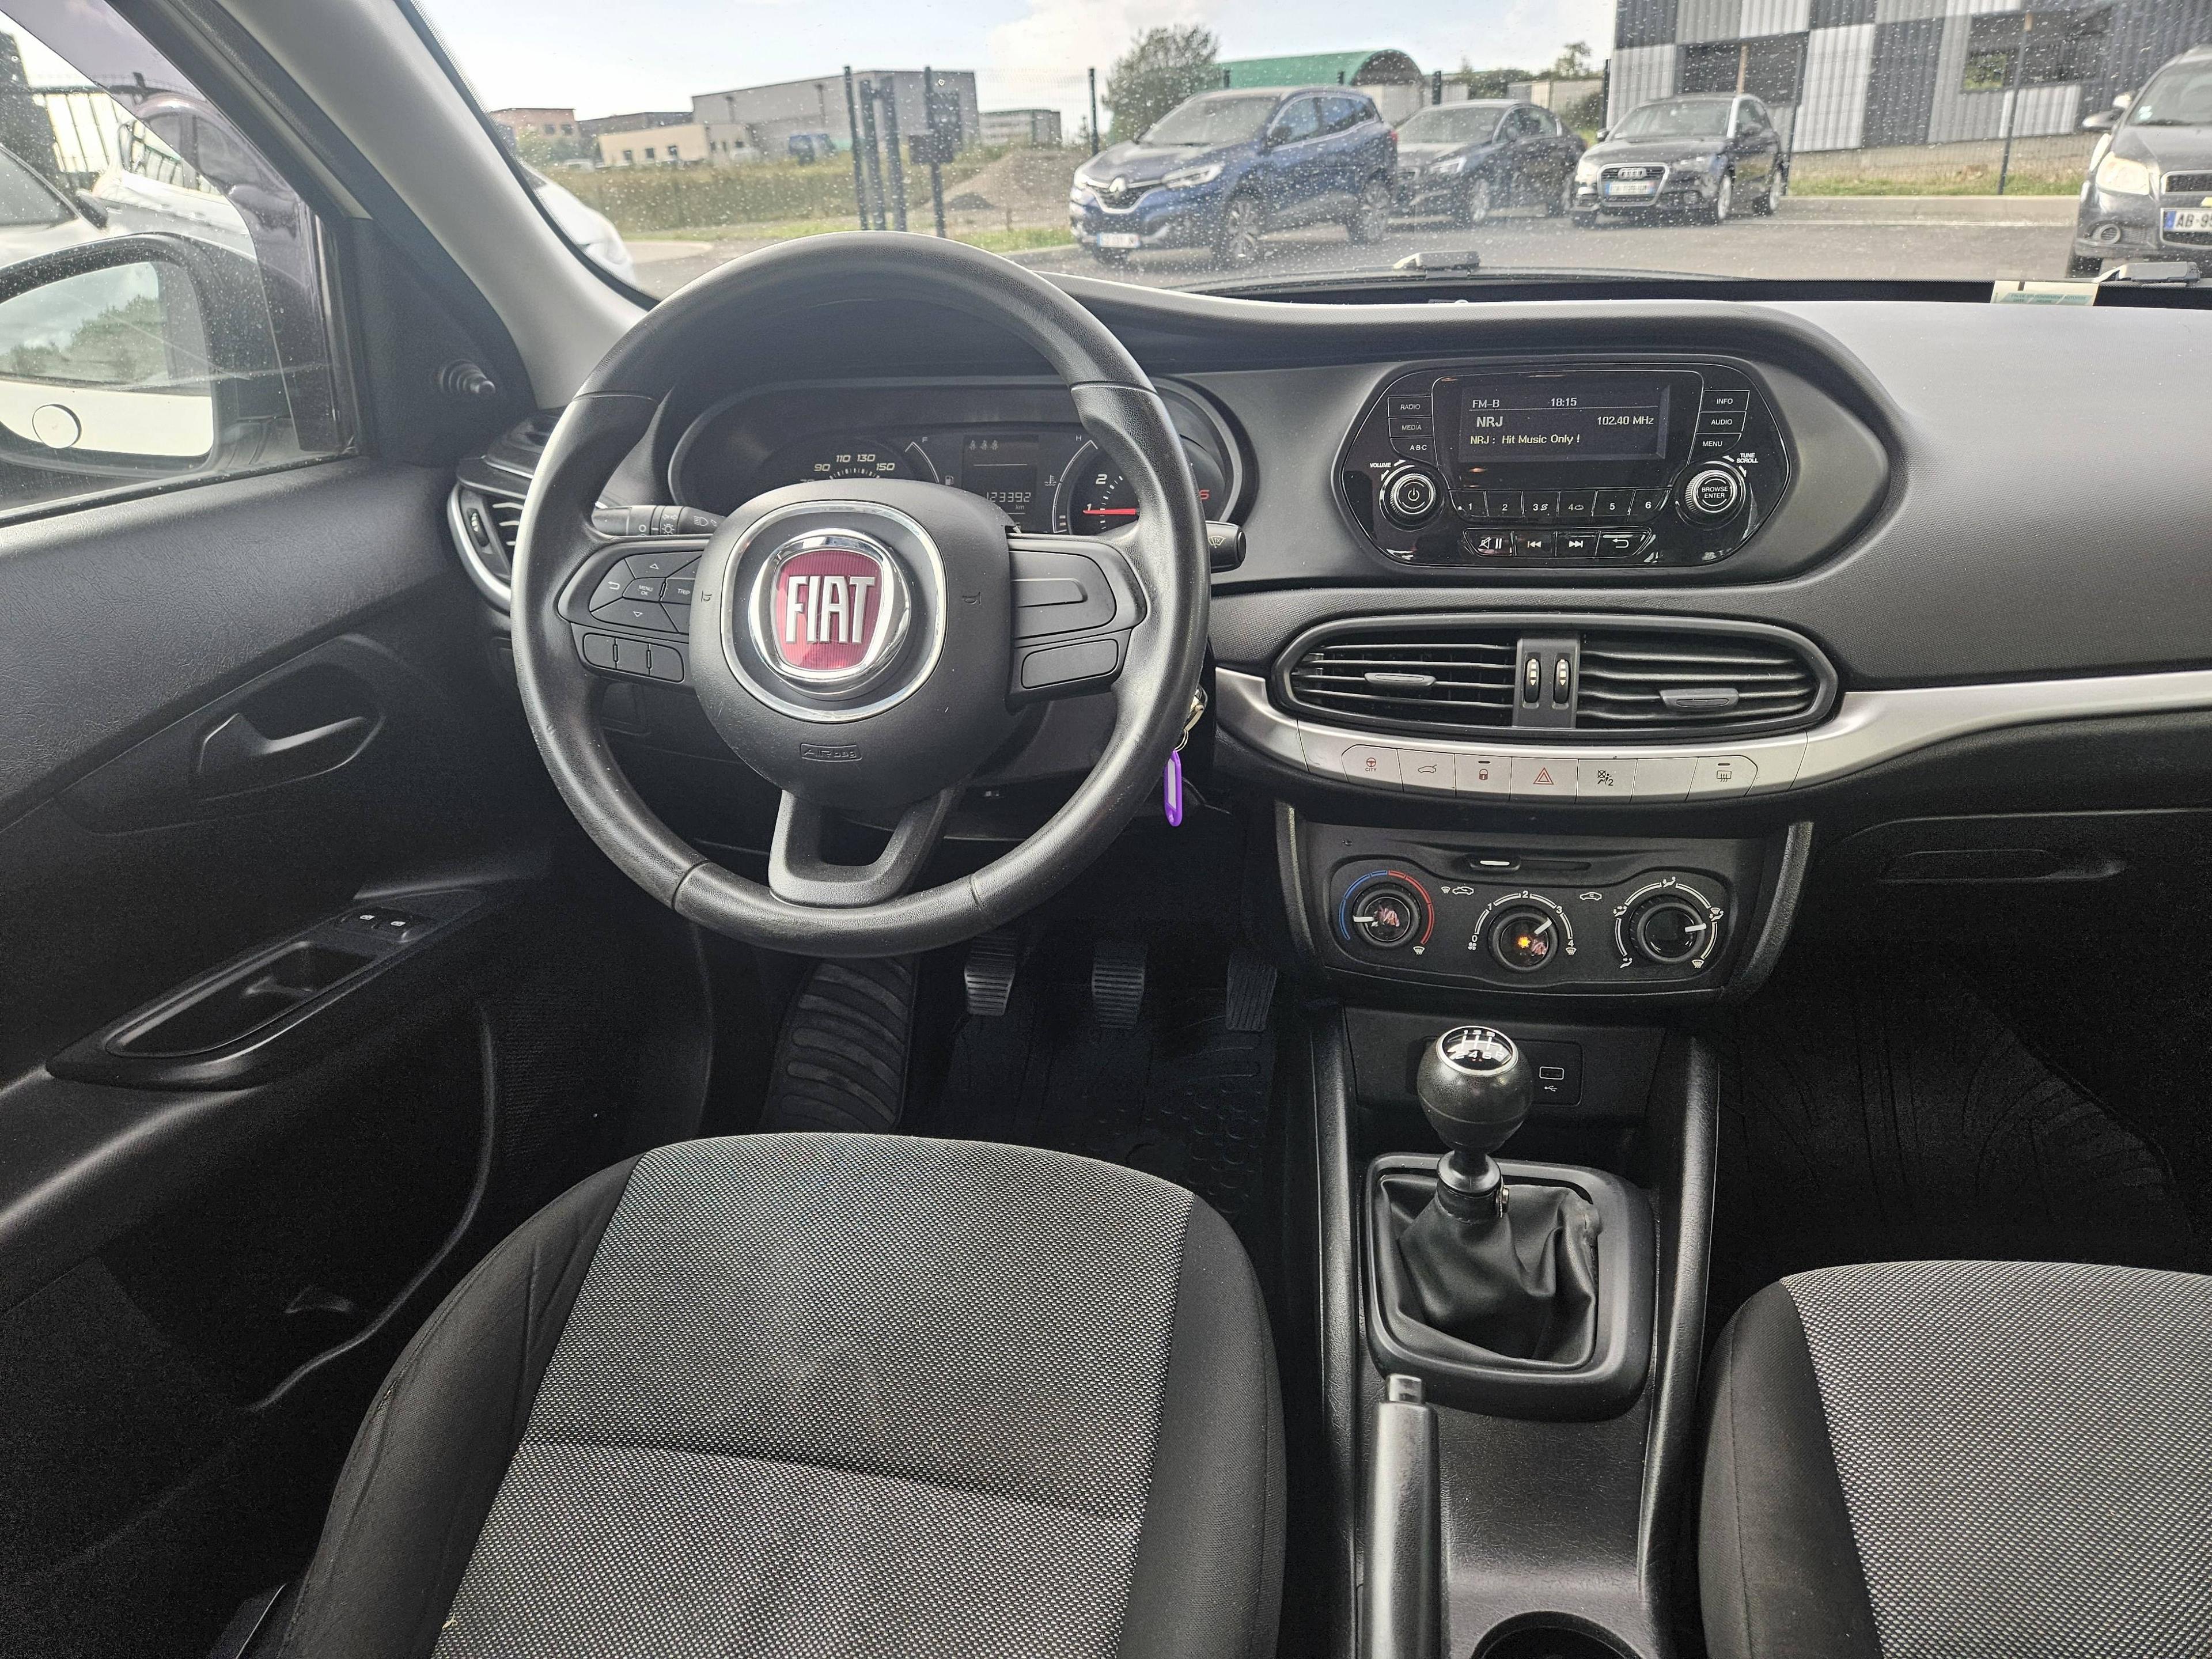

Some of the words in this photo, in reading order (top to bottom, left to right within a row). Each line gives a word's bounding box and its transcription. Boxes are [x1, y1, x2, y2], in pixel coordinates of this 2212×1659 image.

[1472, 399, 1500, 408] FM-B
[1551, 397, 1577, 407] 18:15
[1476, 416, 1503, 427] NRJ
[1597, 416, 1630, 425] 102.40
[1633, 415, 1654, 425] MHz
[1470, 435, 1490, 444] NRJ
[1502, 435, 1517, 444] Hit
[1518, 434, 1547, 444] Music
[1550, 434, 1574, 445] Only
[836, 454, 851, 463] 110
[857, 454, 876, 462] 130
[814, 464, 831, 472] 90
[876, 463, 895, 471] 150
[1095, 474, 1108, 484] 2
[1645, 501, 1652, 509] 6
[786, 575, 876, 645] FIAT
[1522, 891, 1529, 899] 2
[1487, 903, 1493, 911] 1
[1556, 906, 1563, 914] 3
[1469, 1050, 1478, 1058] 4
